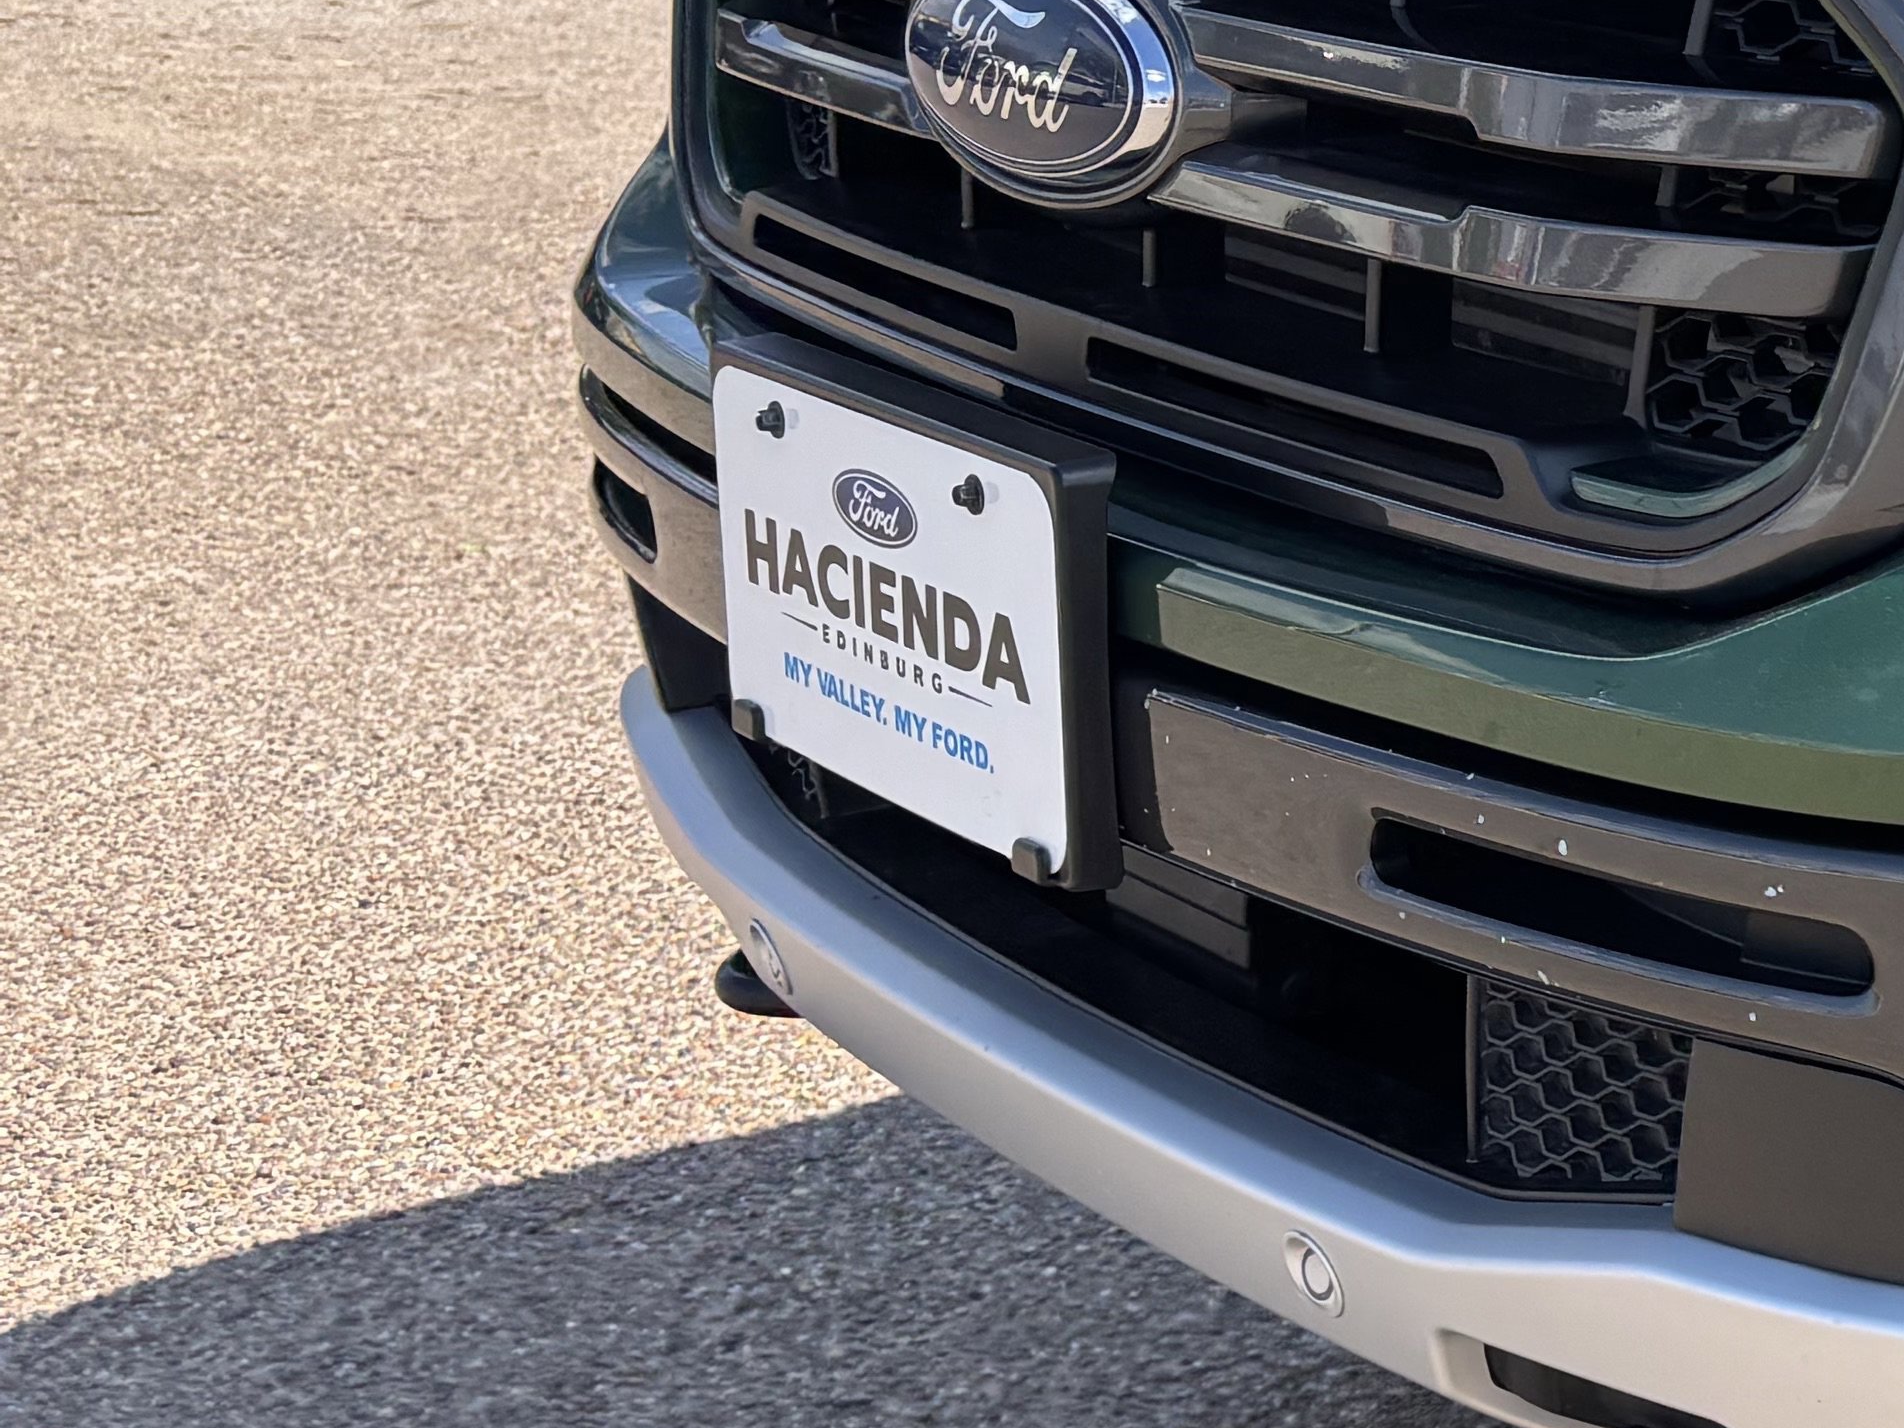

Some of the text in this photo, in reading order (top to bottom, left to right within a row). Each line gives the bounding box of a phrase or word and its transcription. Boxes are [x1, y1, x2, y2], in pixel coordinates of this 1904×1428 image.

[744, 508, 1031, 705] HACIENDA
[822, 623, 944, 694] EDINBURG
[783, 651, 994, 774] MY VALLEY. MY FORD.
